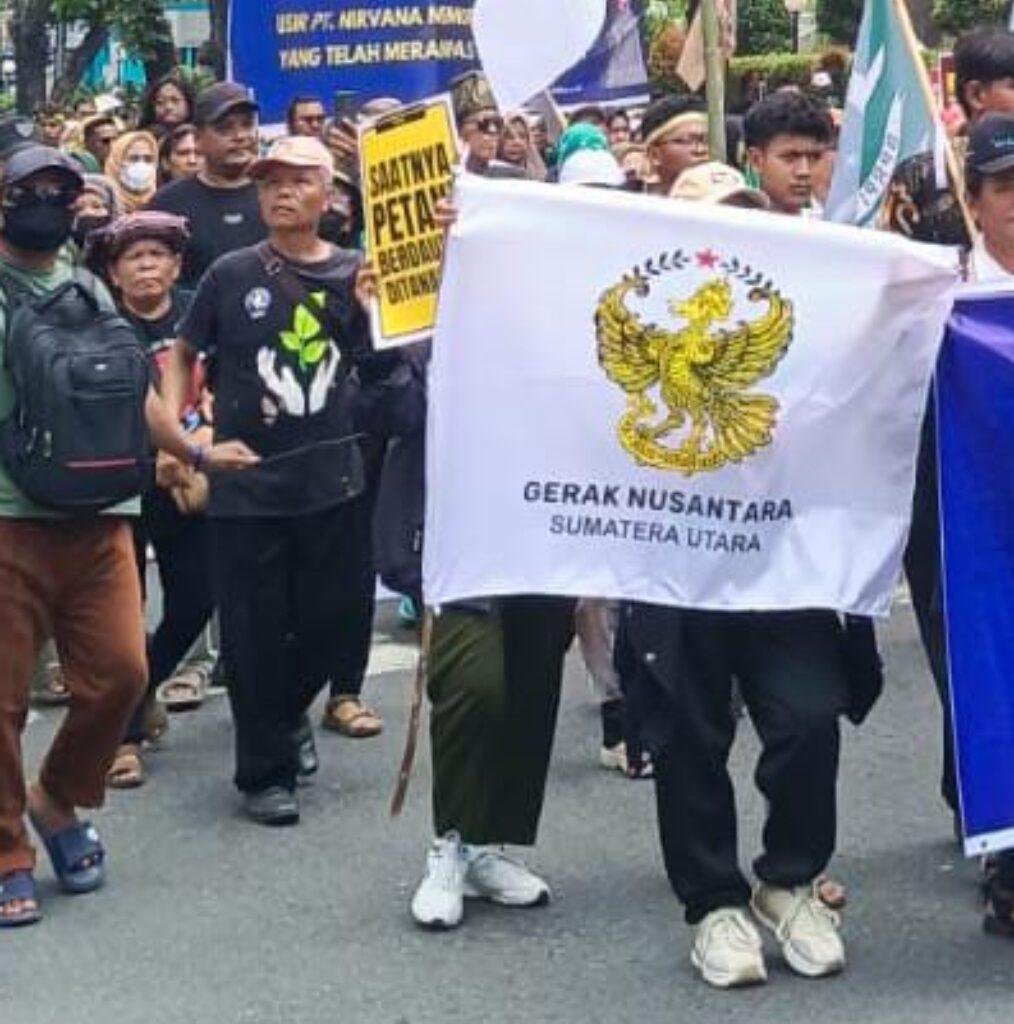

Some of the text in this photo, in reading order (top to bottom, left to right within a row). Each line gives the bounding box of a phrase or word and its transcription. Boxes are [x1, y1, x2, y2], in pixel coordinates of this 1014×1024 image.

[338, 6, 422, 30] NIRVANA
[279, 47, 321, 70] YANG
[326, 43, 380, 66] TELAH
[370, 141, 452, 198] SAATNYA
[372, 179, 454, 246] PETA
[386, 267, 441, 305] DITANA
[523, 480, 794, 524] GERAK NUSANTARA
[550, 514, 762, 553] SUMATERA UTARA
